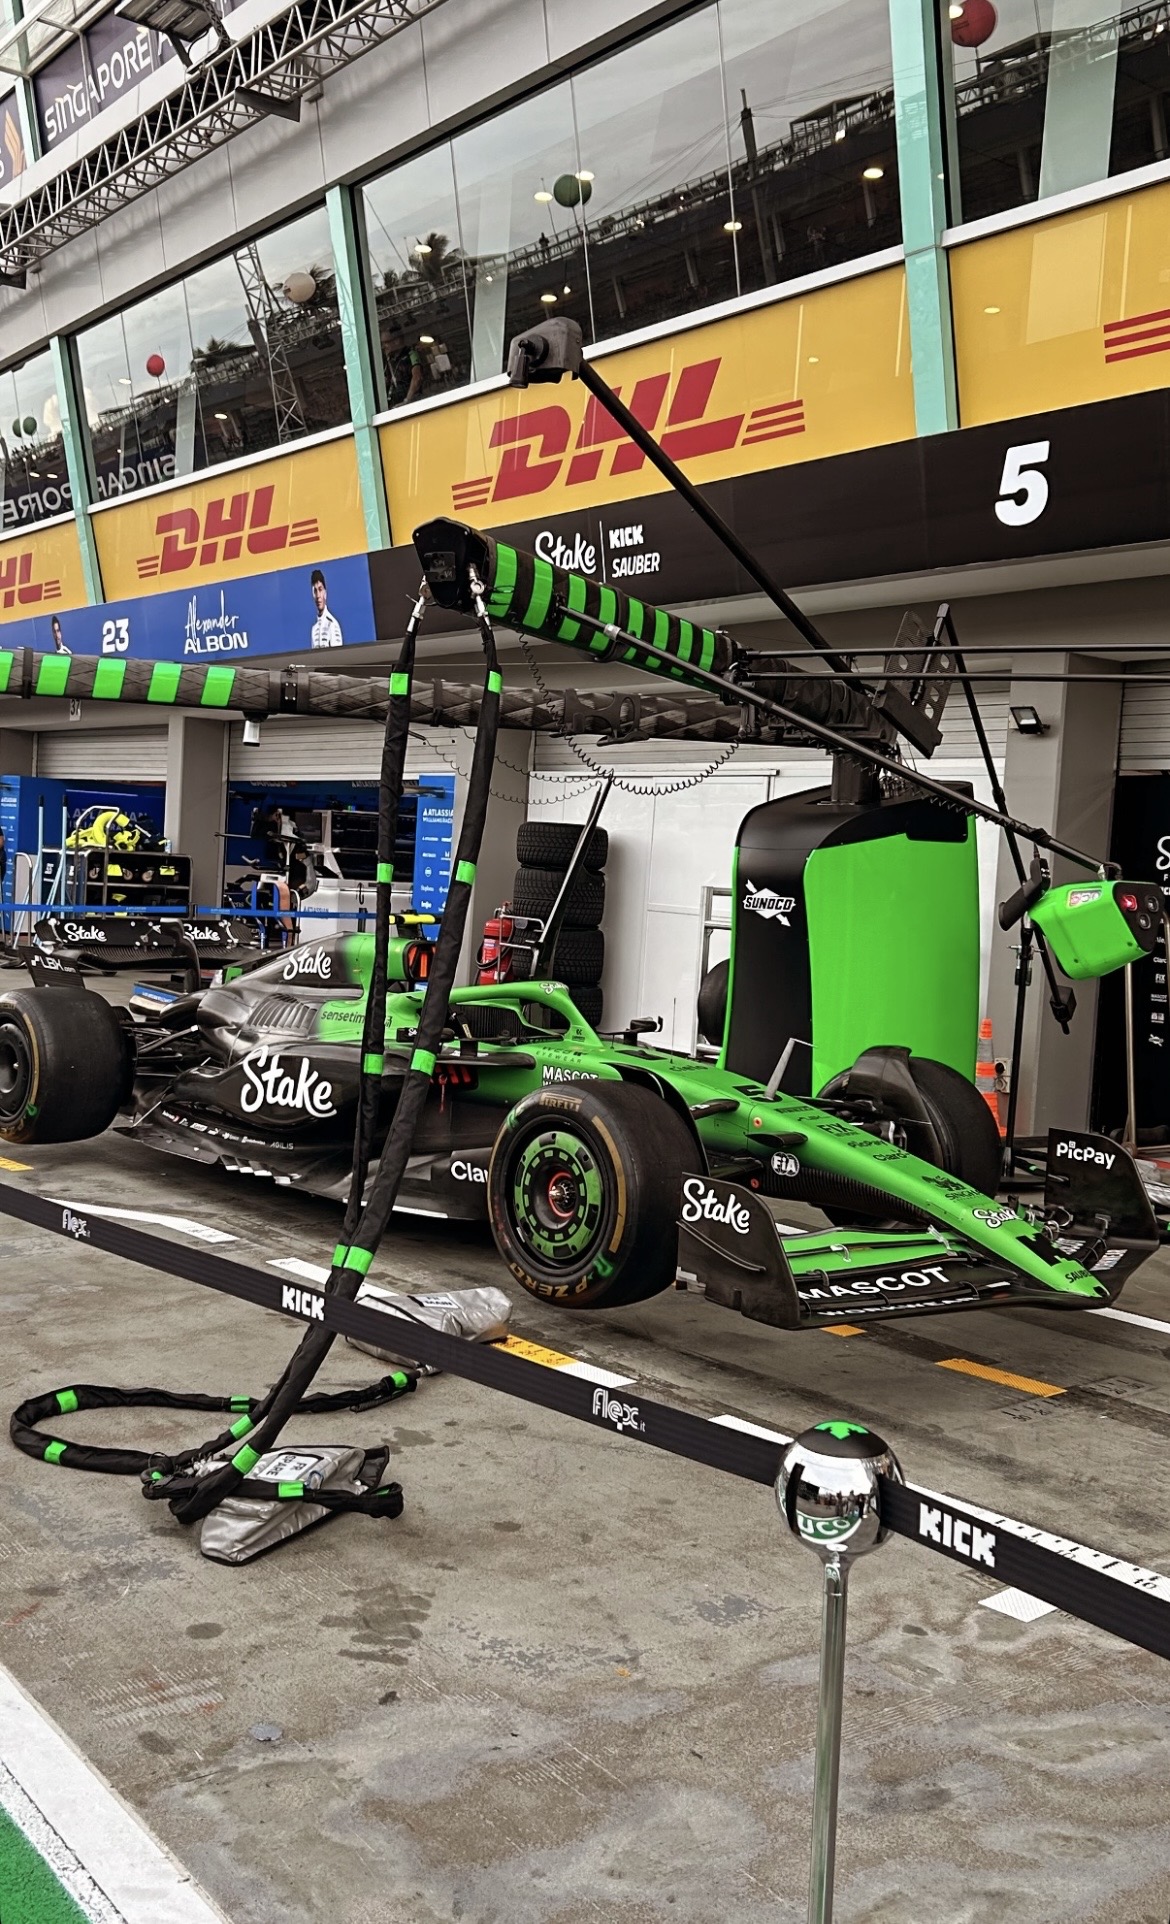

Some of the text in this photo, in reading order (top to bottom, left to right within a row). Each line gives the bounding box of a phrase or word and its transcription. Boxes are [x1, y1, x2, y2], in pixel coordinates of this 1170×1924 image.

[45, 27, 151, 142] SINGAPORE
[489, 357, 746, 503] DHL
[995, 441, 1050, 527] 5
[155, 485, 290, 575] DHL
[609, 524, 644, 549] KICK
[535, 531, 597, 575] Stake
[611, 552, 661, 578] SAUBER
[0, 552, 44, 609] HL
[184, 590, 240, 640] Alexander
[102, 618, 130, 653] 23
[184, 632, 249, 655] ALBON
[745, 896, 794, 911] SUNOCO
[64, 923, 107, 942] Stake
[283, 946, 332, 979] Stake
[320, 1010, 367, 1024] sensetim
[240, 1045, 338, 1119] Stake
[539, 1093, 583, 1113] PIRELLI
[1056, 1141, 1116, 1170] PicPay
[682, 1178, 751, 1235] Stake
[510, 1262, 570, 1298] ZERO
[798, 1266, 951, 1300] MASCOT
[282, 1285, 326, 1321] KICK
[919, 1502, 996, 1568] KICK
